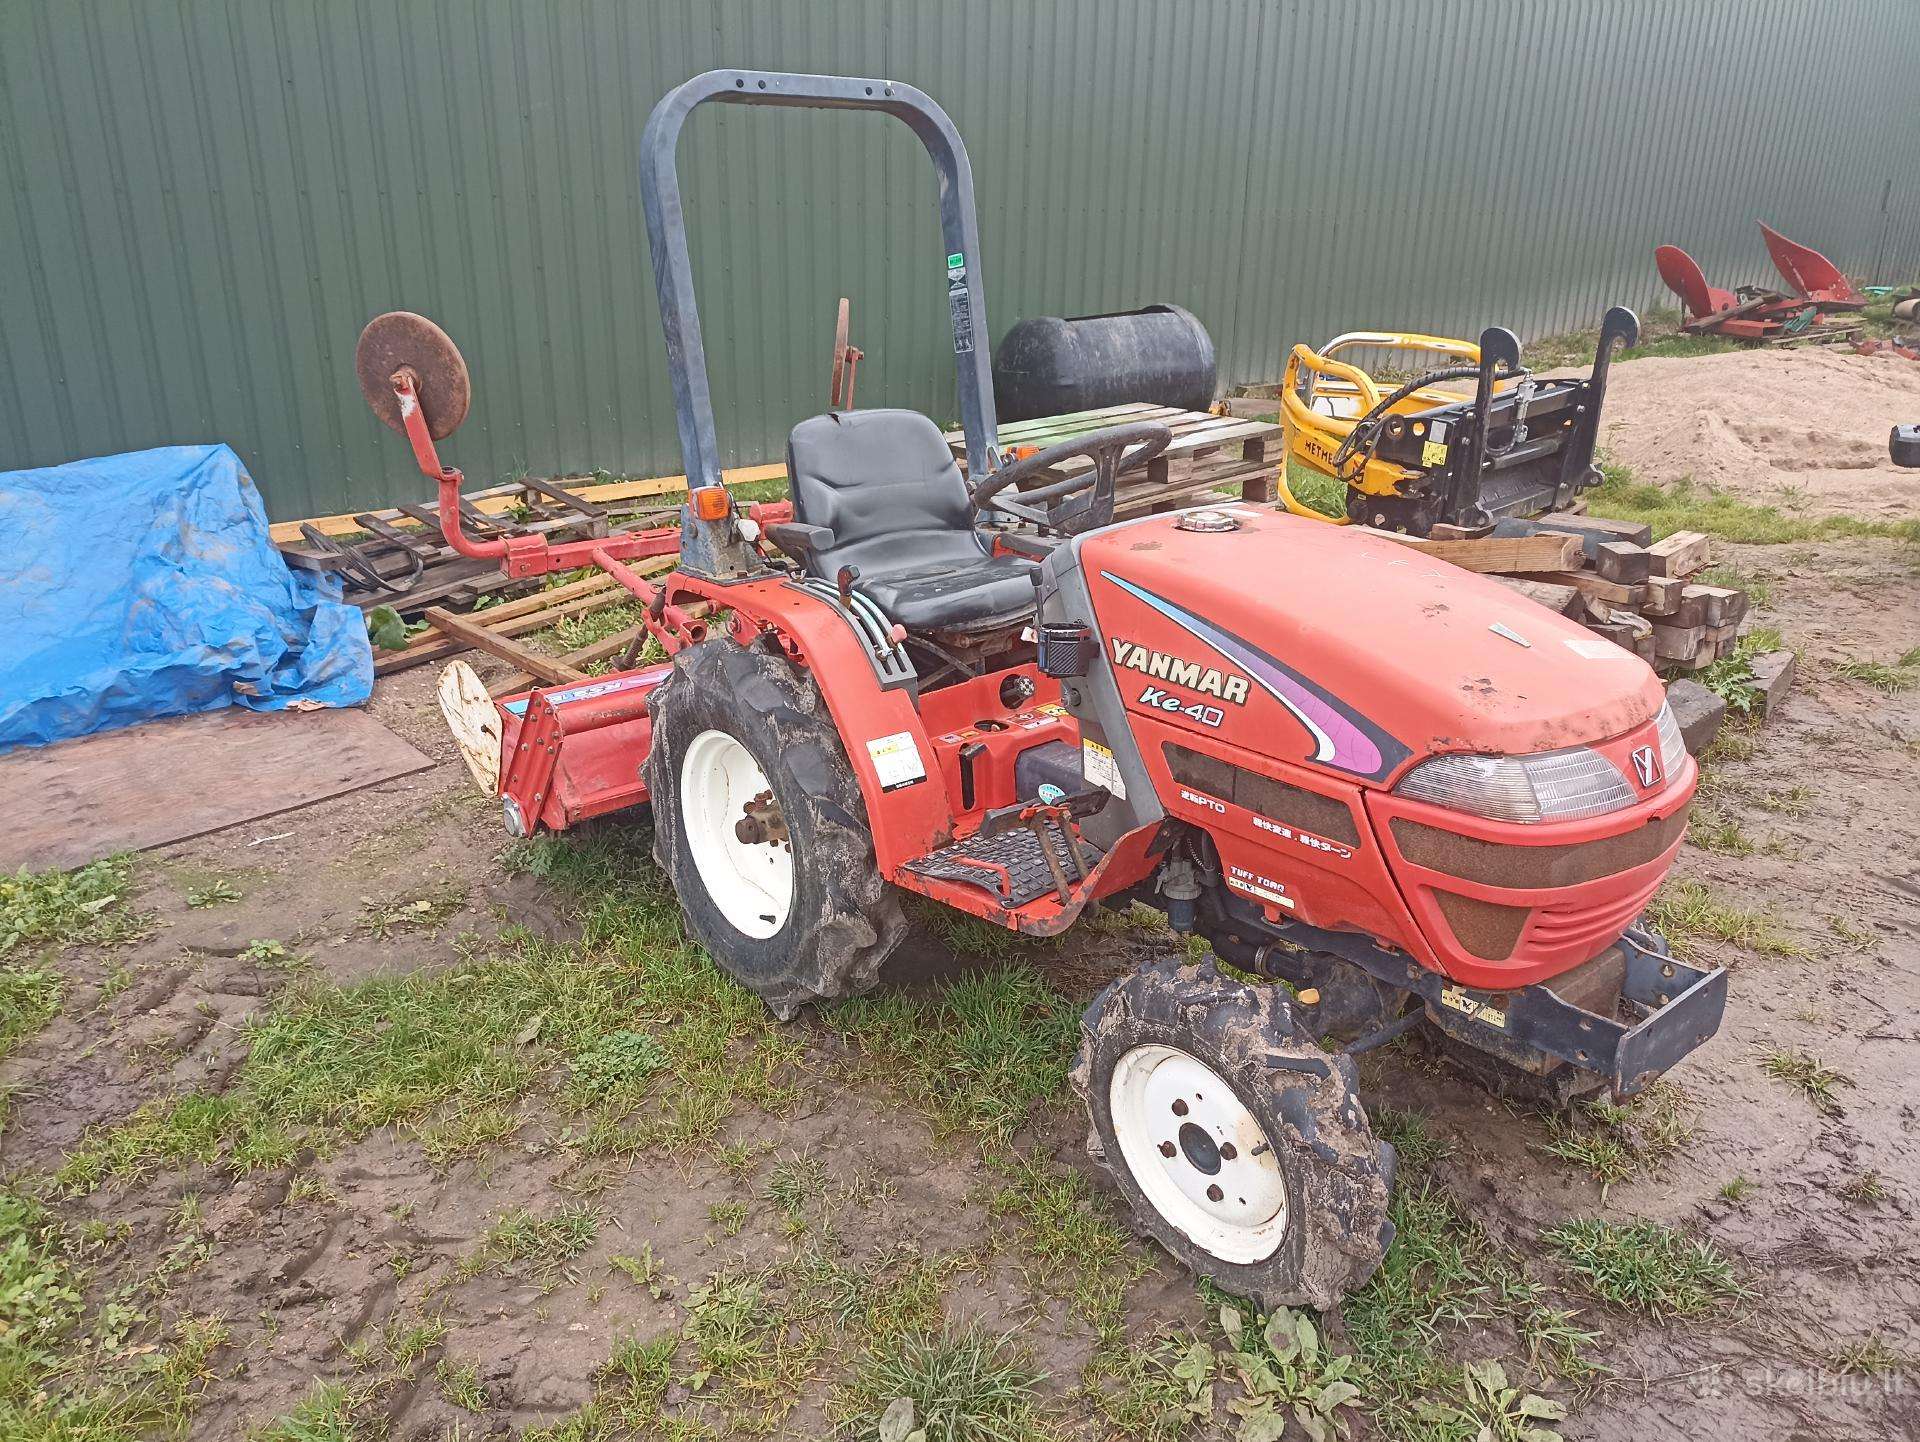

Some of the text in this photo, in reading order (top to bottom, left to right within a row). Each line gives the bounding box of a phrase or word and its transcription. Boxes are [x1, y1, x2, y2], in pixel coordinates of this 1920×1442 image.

[1111, 638, 1250, 705] YANMAR
[1139, 686, 1225, 728] Ke-40
[1230, 866, 1255, 880] TUFF
